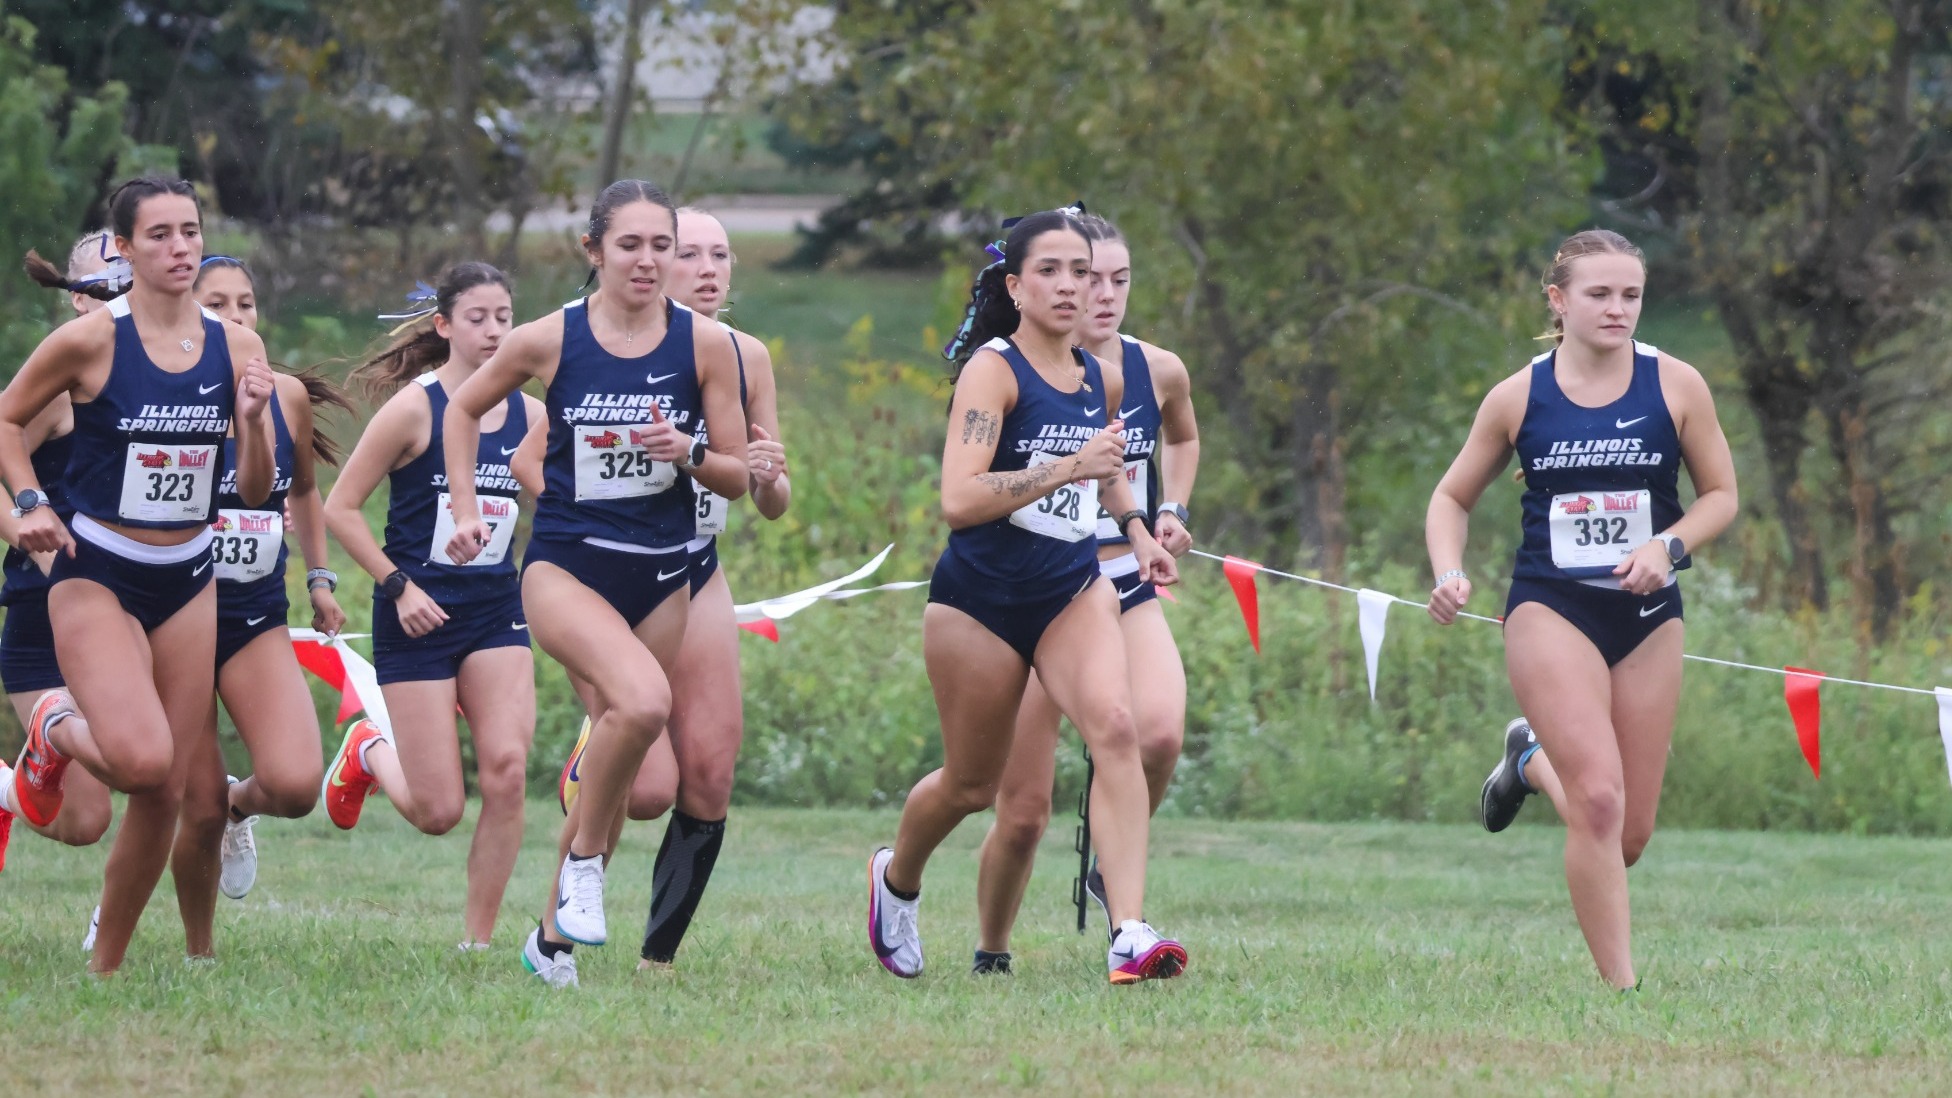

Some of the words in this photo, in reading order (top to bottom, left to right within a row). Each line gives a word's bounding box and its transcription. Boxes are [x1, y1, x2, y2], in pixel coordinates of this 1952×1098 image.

[580, 393, 674, 408] ILLINOIS
[139, 404, 219, 418] ILLINOIS
[117, 418, 228, 432] SPRINGFIELD
[1037, 424, 1103, 439] ILLINO
[1015, 439, 1088, 453] SPRING
[1549, 438, 1643, 455] ILLINOIS
[599, 450, 653, 480] 325
[1532, 453, 1662, 471] SPRINGFIELD
[145, 472, 195, 502] 323
[1037, 487, 1080, 522] 328
[1574, 516, 1629, 547] 332
[212, 536, 259, 565] 333
